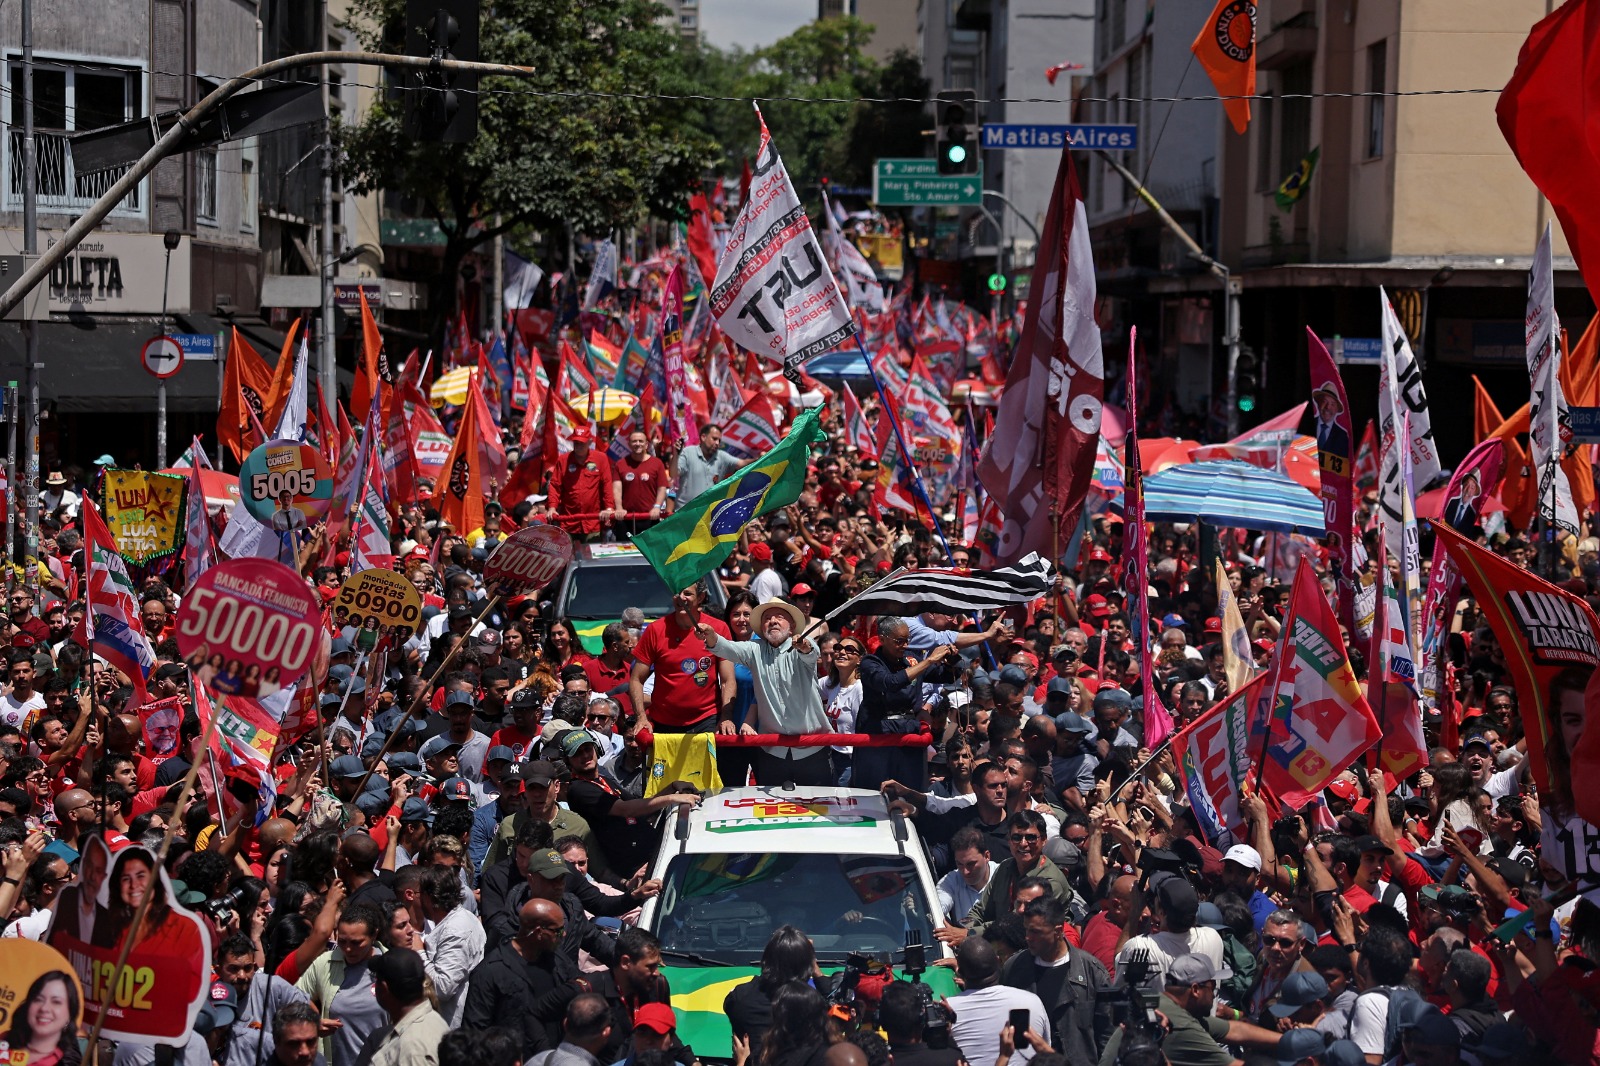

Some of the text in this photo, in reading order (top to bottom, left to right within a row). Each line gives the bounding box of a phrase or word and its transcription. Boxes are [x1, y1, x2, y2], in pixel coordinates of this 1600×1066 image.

[986, 127, 1132, 146] Matias Aires
[900, 164, 936, 174] Jardins
[914, 180, 960, 190] Pinheiros
[903, 191, 960, 201] Sto. Amaro
[49, 256, 123, 291] OLETA
[191, 335, 211, 347] Aires
[1344, 340, 1370, 352] Matias
[1413, 437, 1434, 461] DOS
[266, 456, 295, 467] CORTEZ
[252, 468, 316, 500] 5005
[122, 524, 158, 538] LULA
[487, 543, 565, 583] 50000
[214, 571, 262, 600] BANCADA
[262, 588, 310, 615] FEMINISTA
[358, 581, 406, 600] pretas
[339, 586, 419, 623] 50900
[1508, 590, 1594, 640] LUNA
[180, 587, 315, 671] 50000
[1544, 649, 1579, 661] DEPUTADA
[1294, 750, 1326, 777] 13
[758, 804, 811, 816] 13
[710, 815, 864, 829] HADDAD
[92, 959, 155, 1010] 1302
